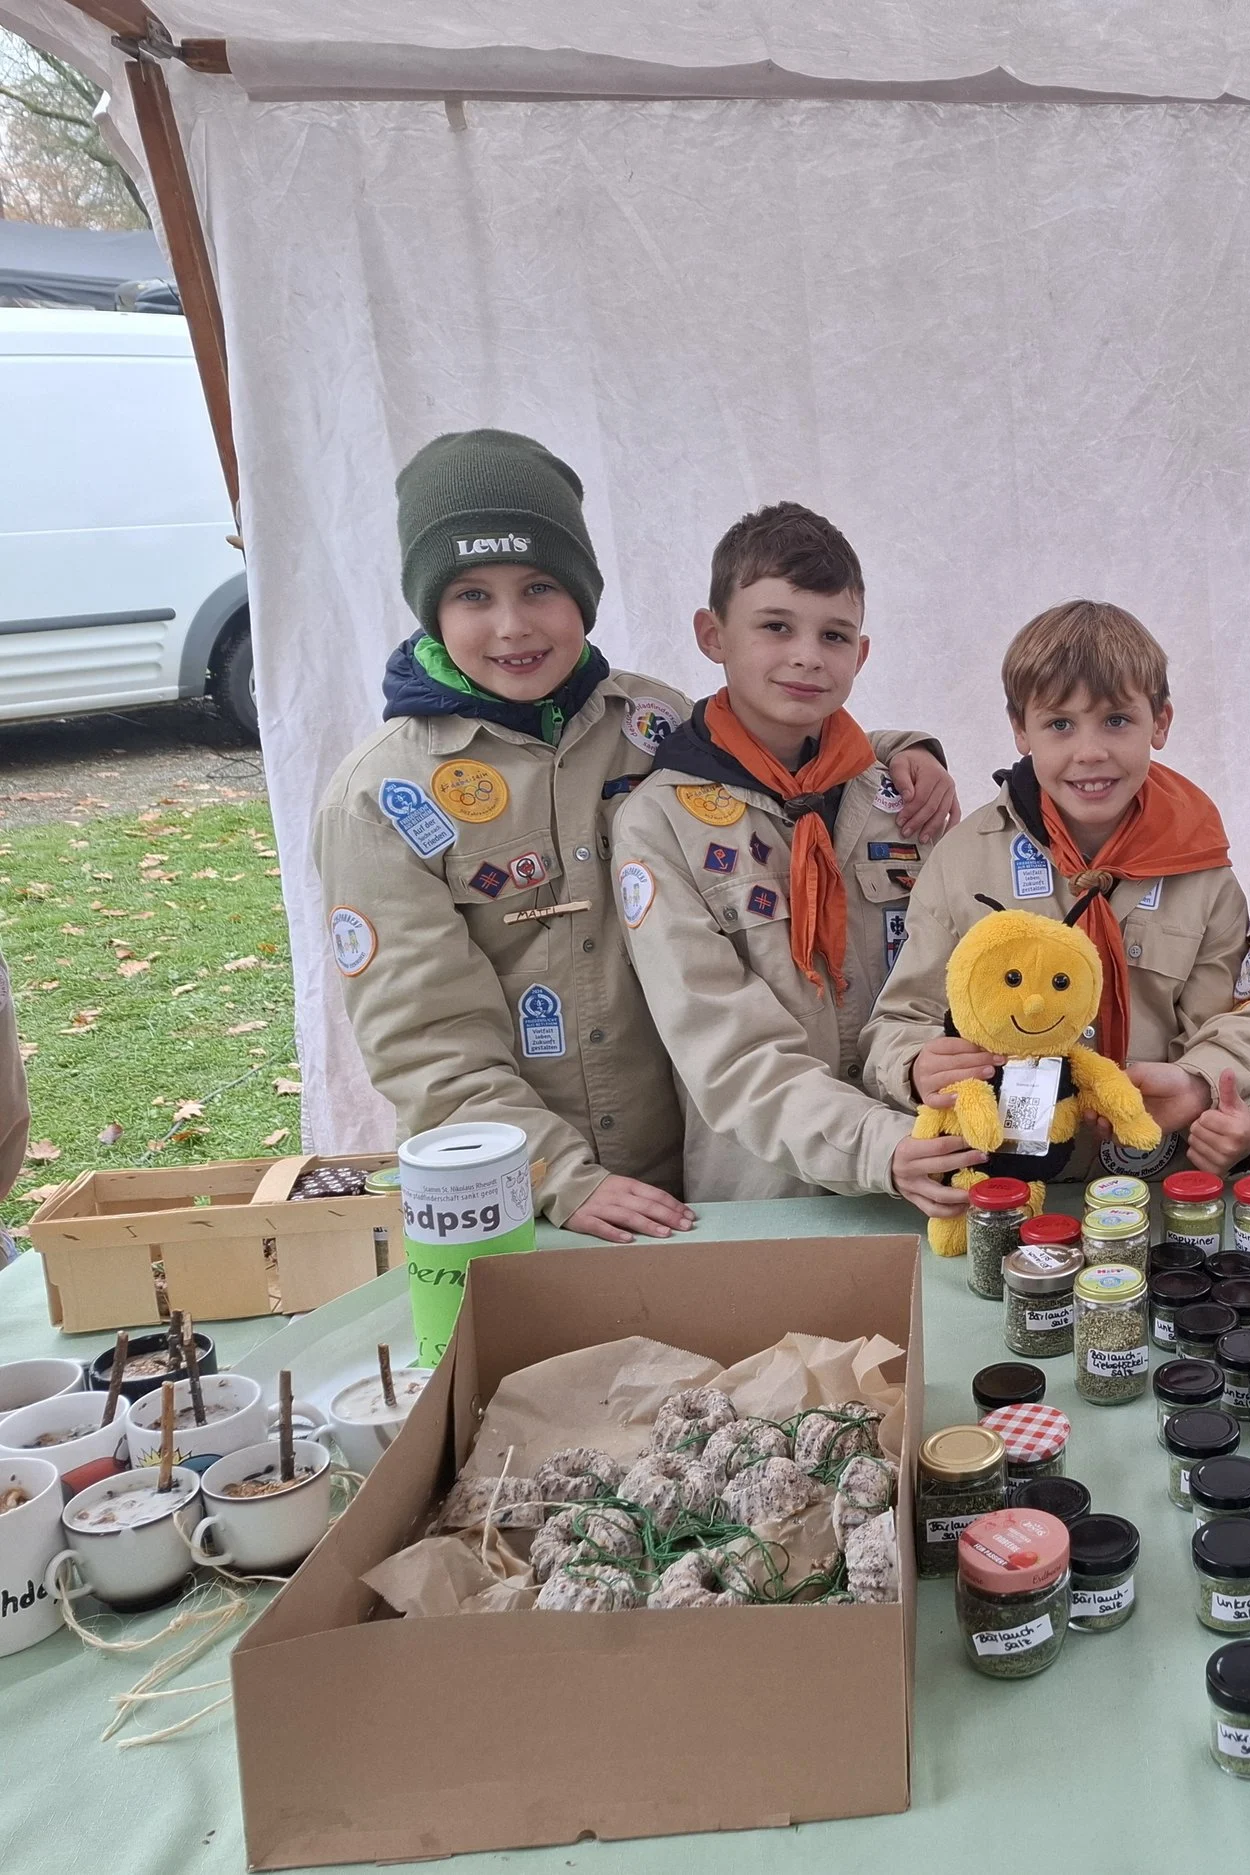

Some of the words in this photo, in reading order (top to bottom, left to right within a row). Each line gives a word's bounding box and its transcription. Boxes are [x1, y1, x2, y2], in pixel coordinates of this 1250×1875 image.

[456, 533, 529, 556] Levi's
[412, 825, 425, 836] Auf
[450, 1185, 475, 1193] Nikolaus
[461, 1192, 480, 1200] sankt
[481, 1187, 498, 1198] georg
[417, 1203, 501, 1238] dpsg
